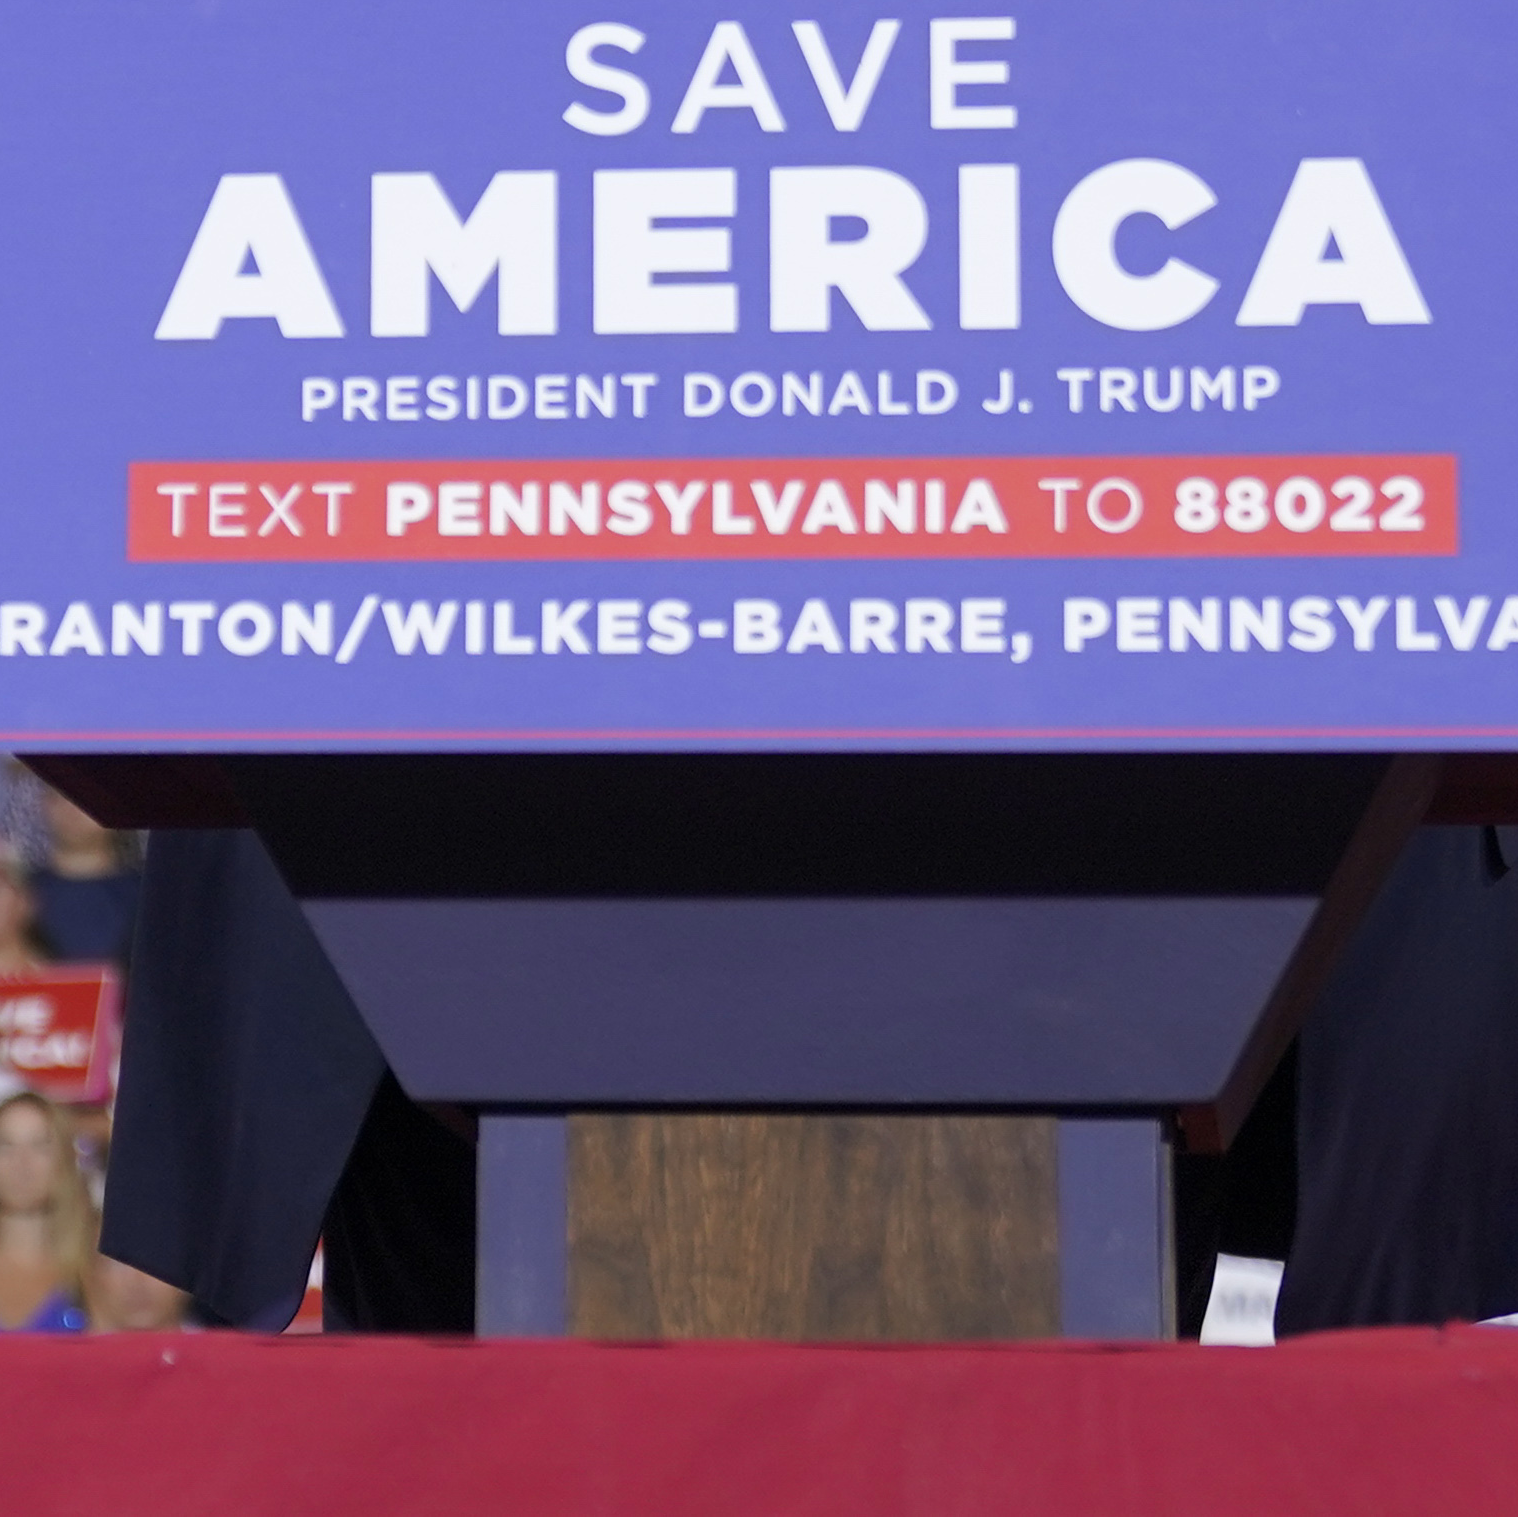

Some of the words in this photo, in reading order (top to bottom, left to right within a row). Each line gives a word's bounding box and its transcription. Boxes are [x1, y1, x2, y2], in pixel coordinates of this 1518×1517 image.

[562, 17, 1017, 138] SAVE
[153, 156, 1432, 342] AMERICA
[300, 375, 657, 423] PRESIDENT
[682, 371, 957, 419] DONALD
[982, 370, 1032, 416] J.
[1056, 365, 1280, 414] TRUMP
[155, 483, 352, 539] TEXT
[385, 479, 1007, 538] PENNSYLVANIA
[1036, 478, 1143, 535] TO
[1172, 475, 1425, 535] 88022
